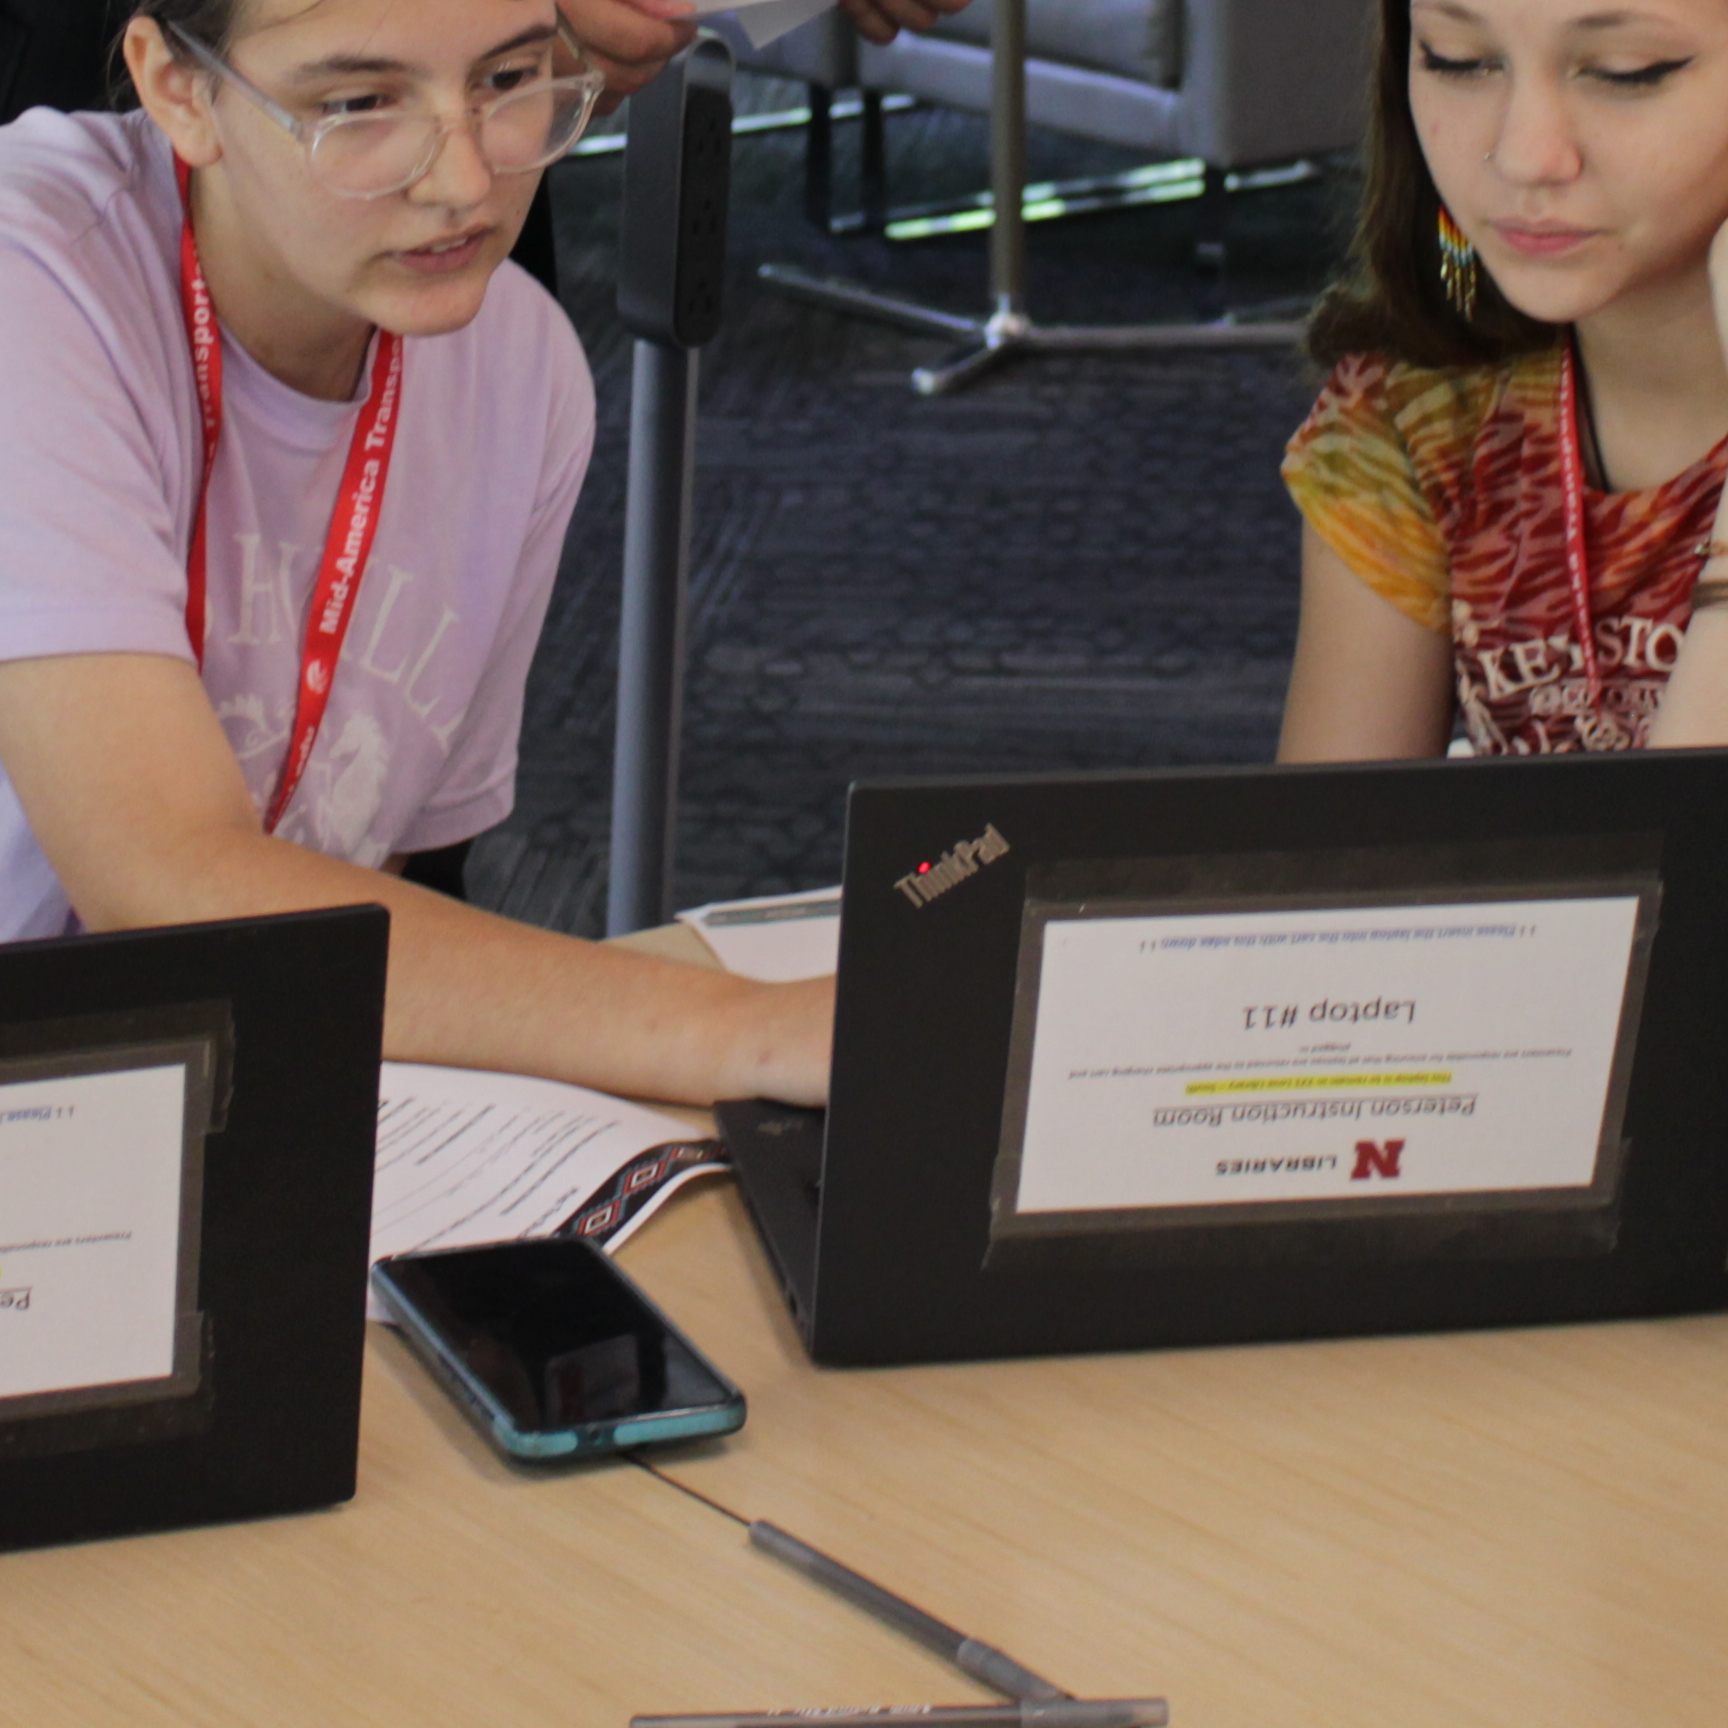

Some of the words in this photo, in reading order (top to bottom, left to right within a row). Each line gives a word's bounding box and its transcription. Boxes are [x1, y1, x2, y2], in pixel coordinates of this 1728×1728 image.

[319, 459, 380, 635] Mid-America
[893, 822, 1010, 909] ThinkPad
[1244, 1005, 1298, 1029] #11
[1308, 997, 1415, 1023] Laptop
[5, 1105, 52, 1122] Please
[1152, 1104, 1223, 1127] Room
[1230, 1098, 1362, 1122] Instruction
[1370, 1093, 1477, 1116] Peterson
[1216, 1155, 1337, 1175] LIBRARIES
[1350, 1138, 1404, 1180] N
